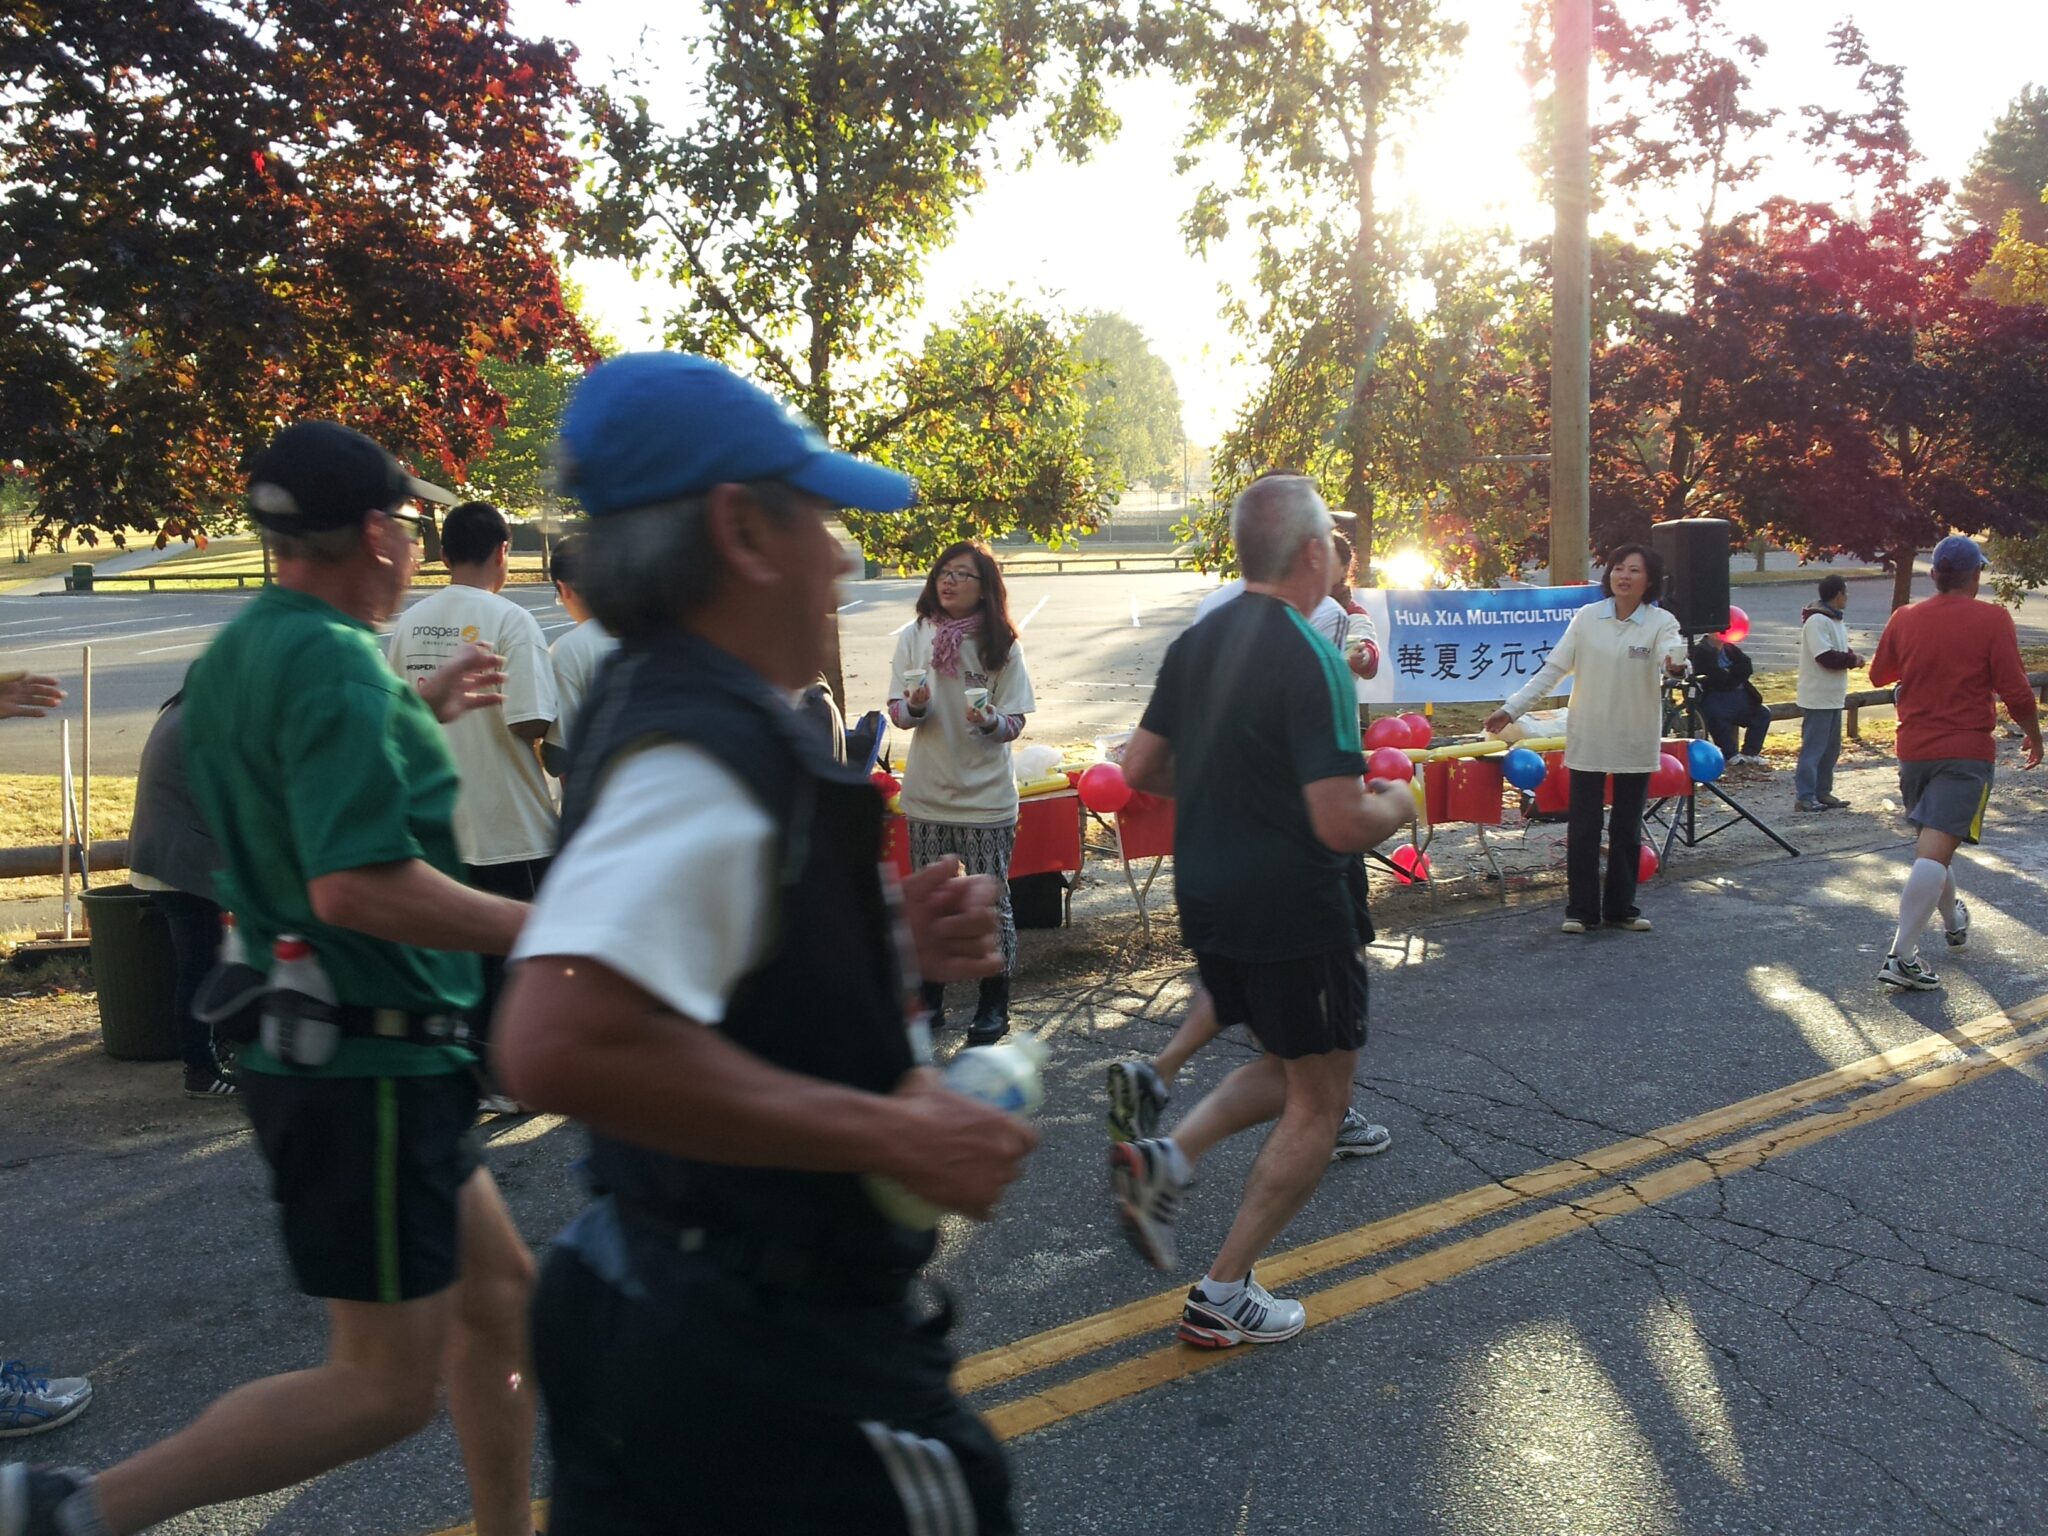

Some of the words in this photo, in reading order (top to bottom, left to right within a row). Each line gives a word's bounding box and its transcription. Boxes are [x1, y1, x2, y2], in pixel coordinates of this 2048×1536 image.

[1395, 609, 1433, 626] HUA
[1434, 609, 1464, 626] XIA
[412, 626, 460, 640] prospea
